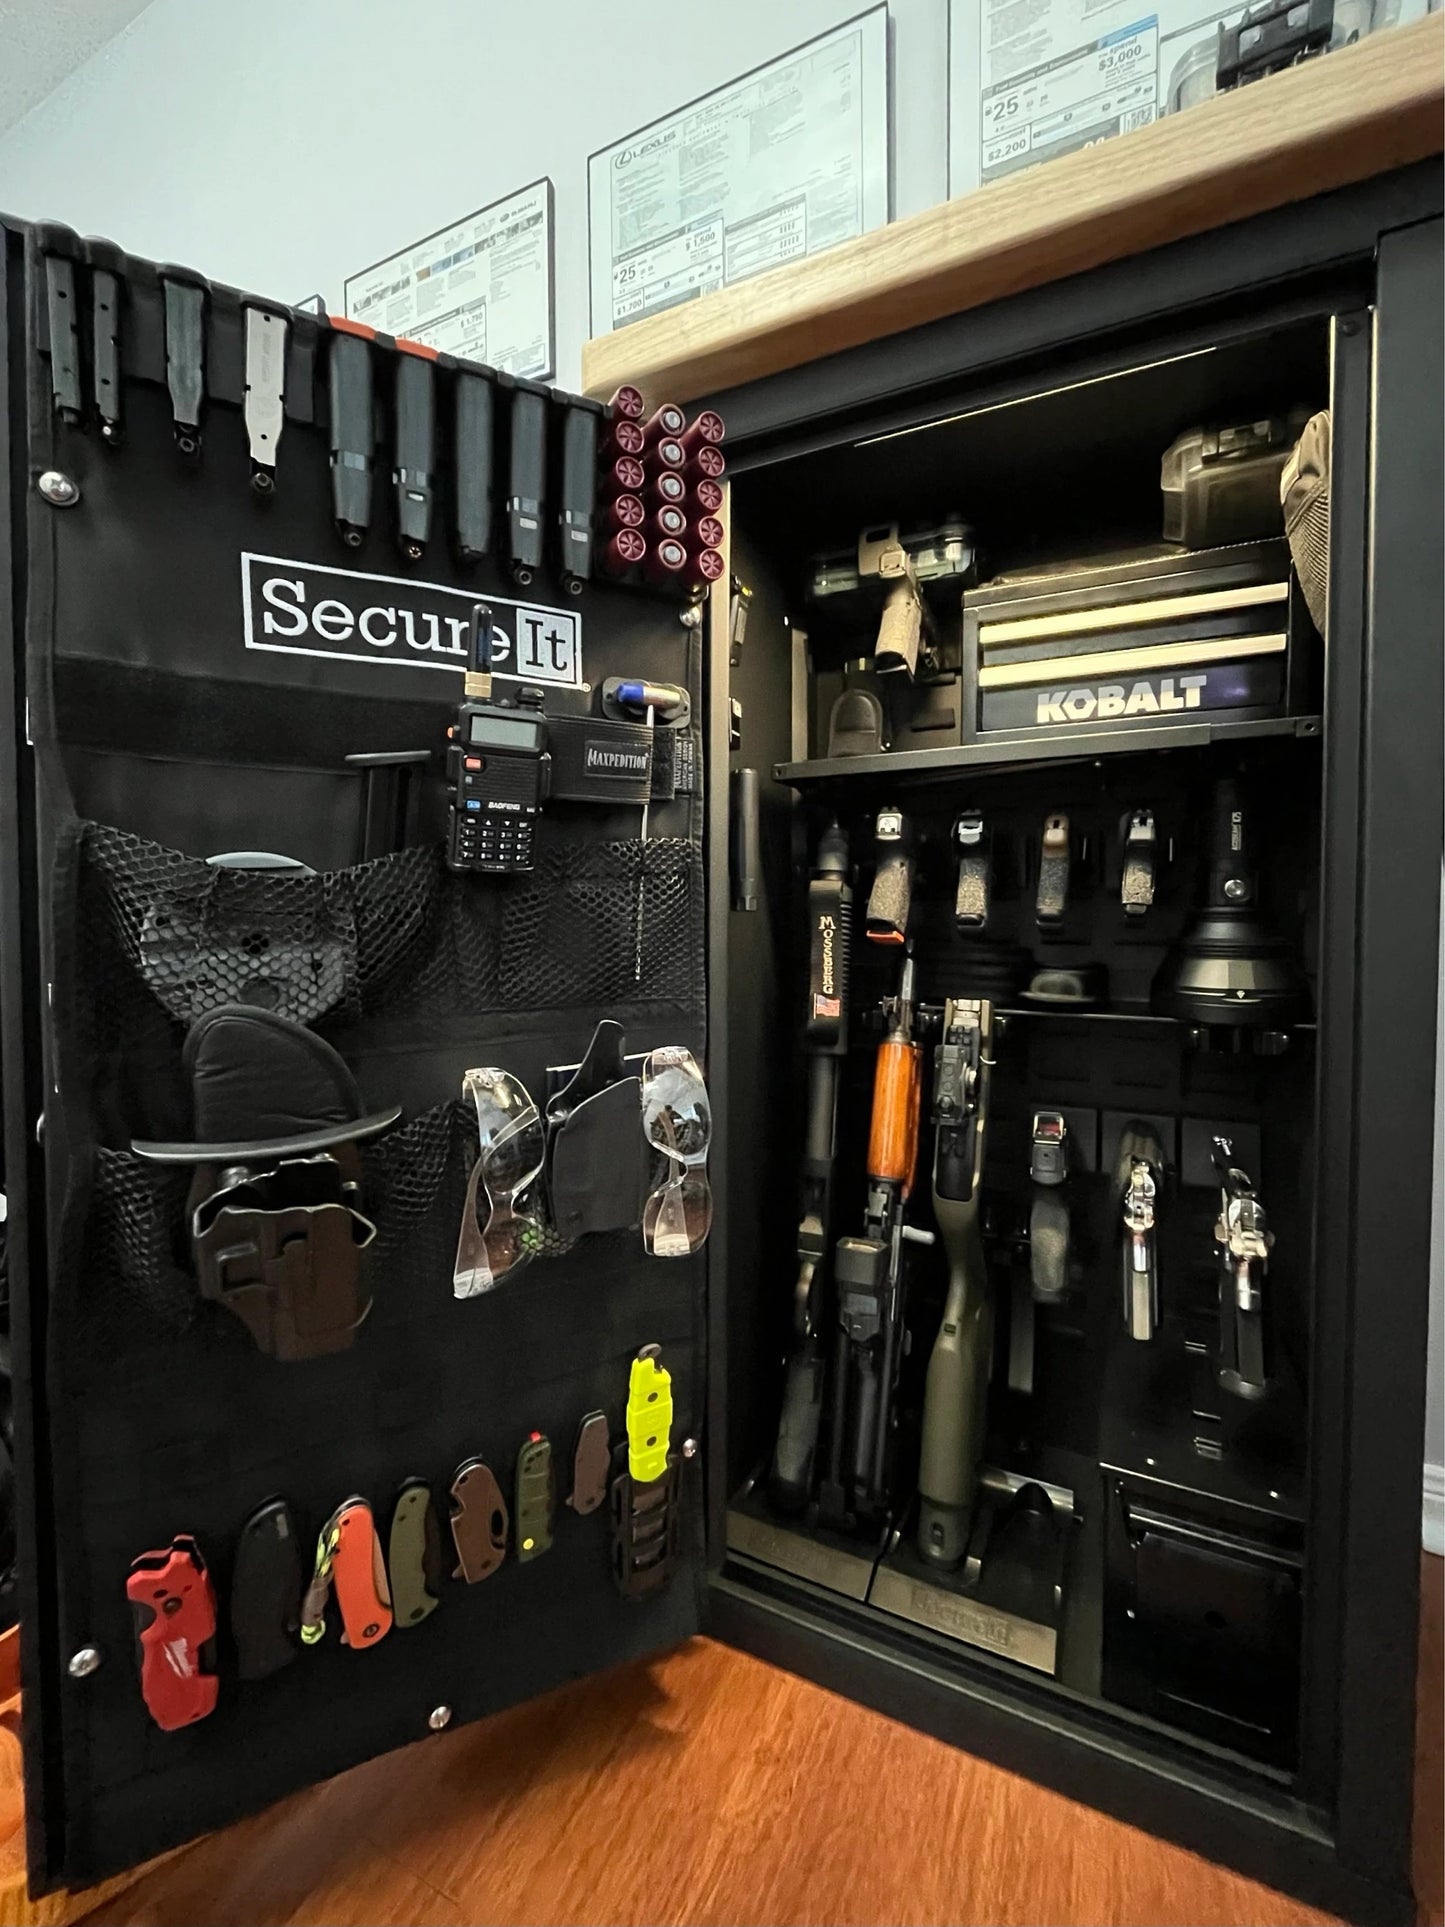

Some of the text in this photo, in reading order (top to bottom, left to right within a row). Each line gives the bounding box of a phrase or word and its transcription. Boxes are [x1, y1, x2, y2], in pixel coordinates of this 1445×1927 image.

[1098, 45, 1142, 72] $3,000
[993, 95, 1019, 121] 25
[988, 139, 1026, 161] $2,200
[619, 264, 636, 284] 25
[1037, 675, 1207, 723] KOBALT
[587, 748, 648, 769] MAXPEDITION
[488, 801, 520, 811] BAOFENG
[818, 916, 836, 994] MOSSBERG
